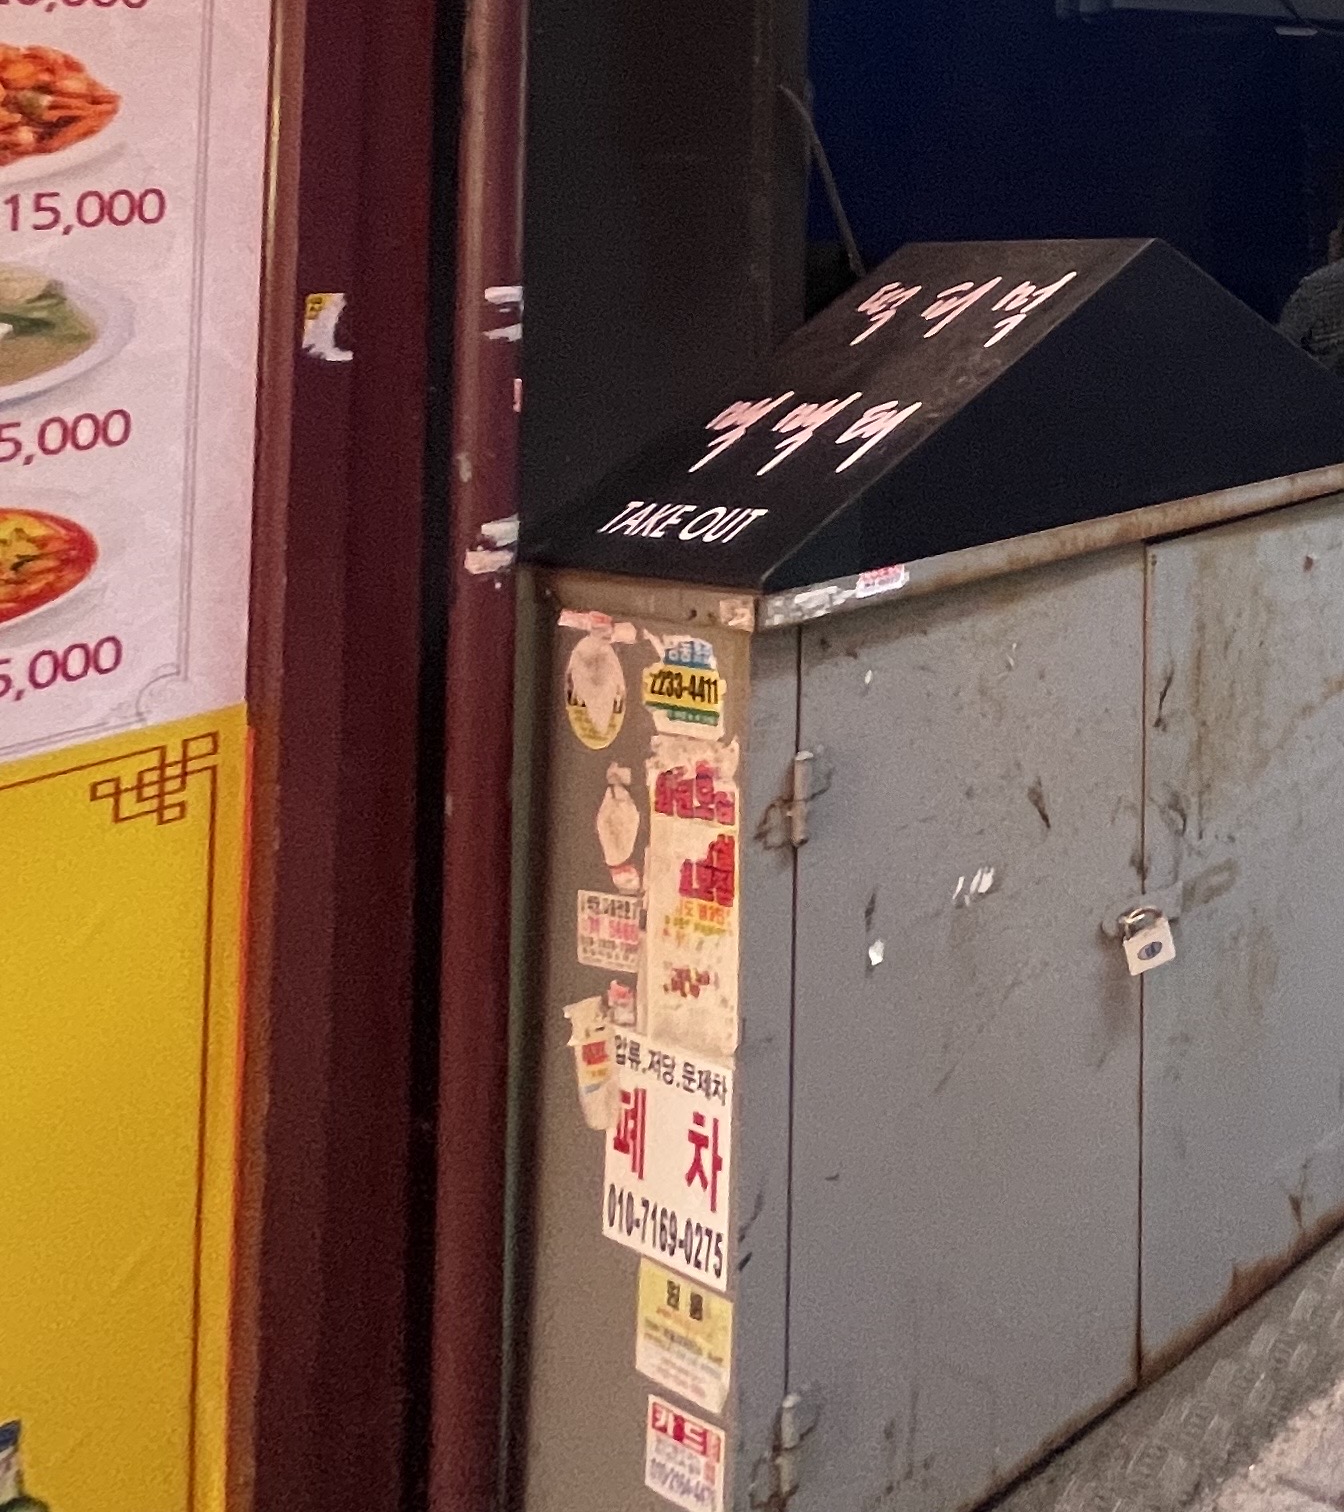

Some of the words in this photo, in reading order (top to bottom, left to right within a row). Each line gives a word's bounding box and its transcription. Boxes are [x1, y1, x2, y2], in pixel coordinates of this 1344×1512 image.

[4, 188, 166, 236] 15,000
[597, 501, 696, 540] TAKE
[679, 505, 768, 542] OUT
[650, 669, 719, 705] 2233-4411
[606, 1183, 724, 1280] 010-7169-0275
